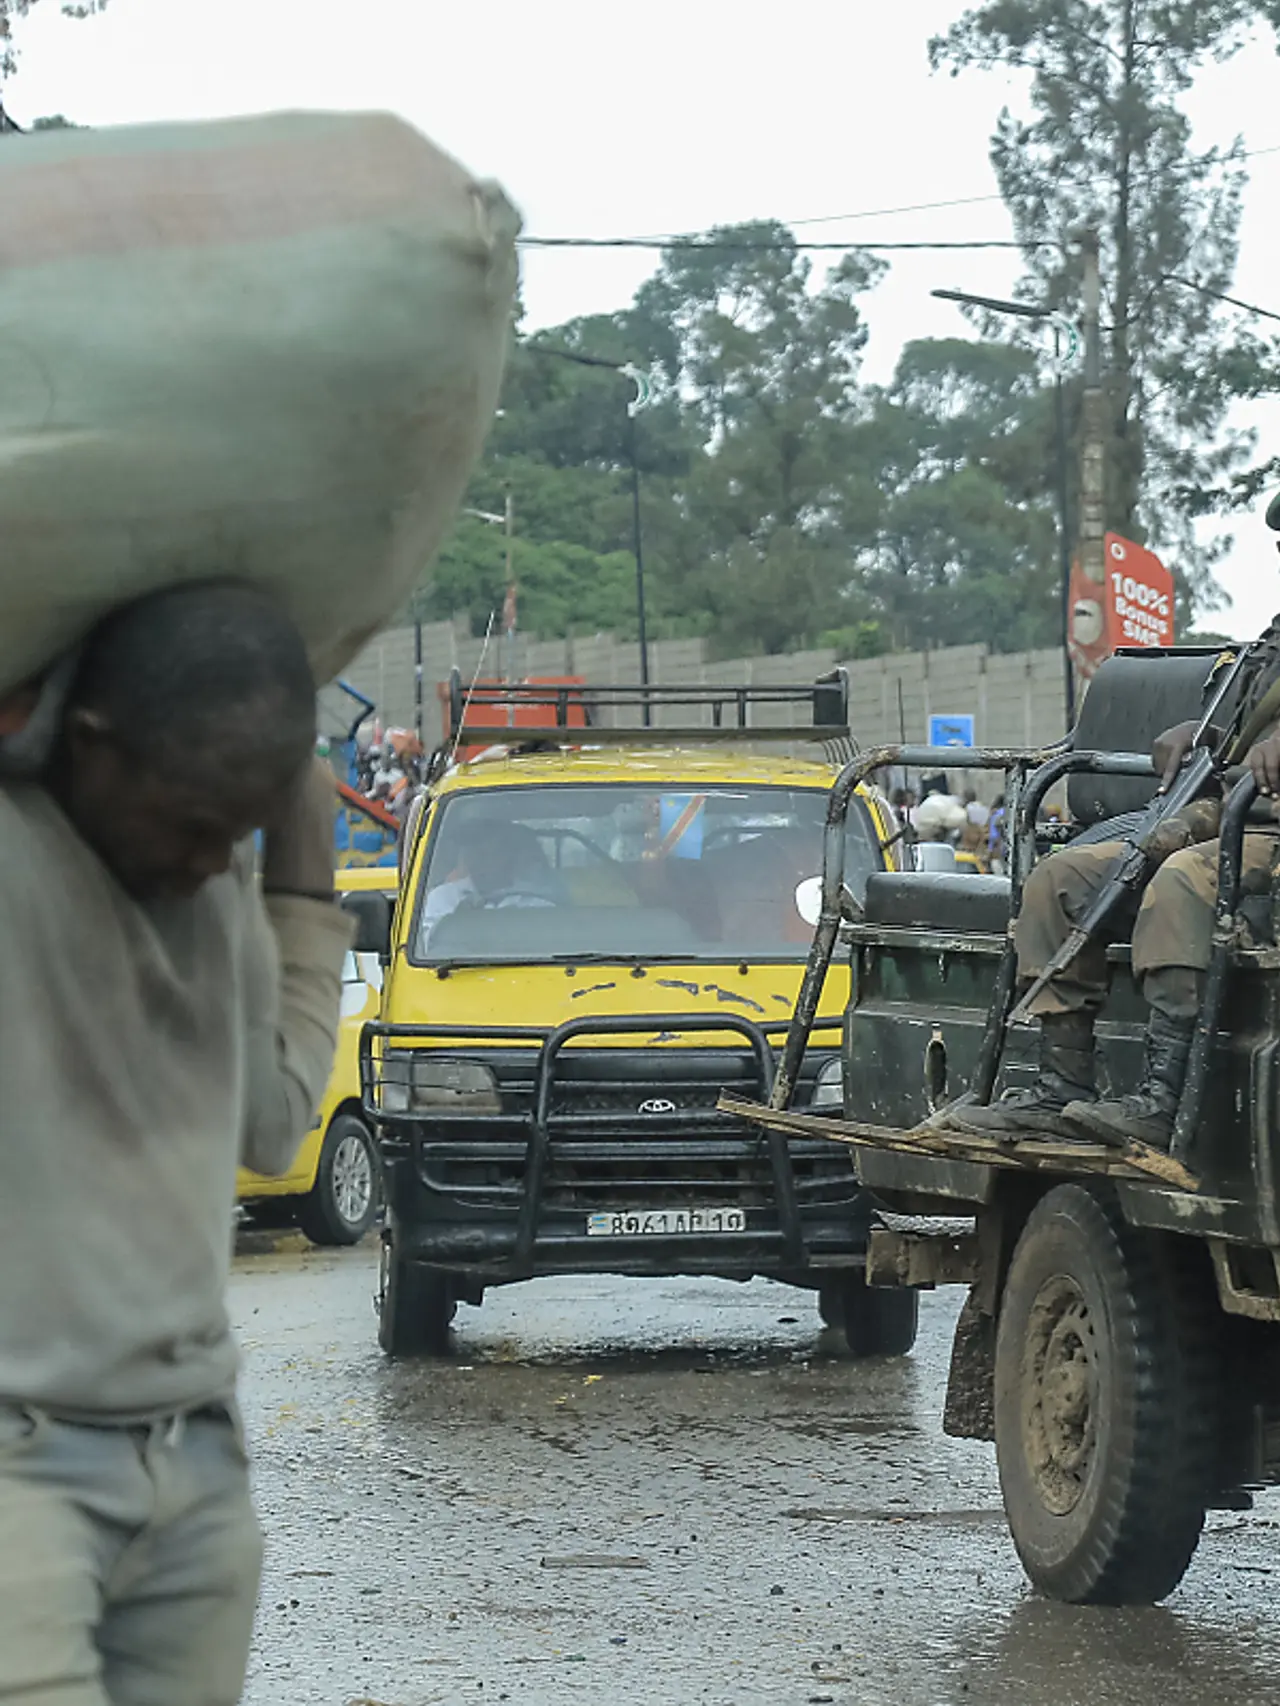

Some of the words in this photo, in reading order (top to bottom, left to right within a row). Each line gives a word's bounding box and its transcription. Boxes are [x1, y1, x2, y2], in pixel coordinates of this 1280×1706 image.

[1111, 572, 1168, 615] 100%
[1115, 596, 1168, 634] Bonus
[1122, 619, 1161, 647] SMS
